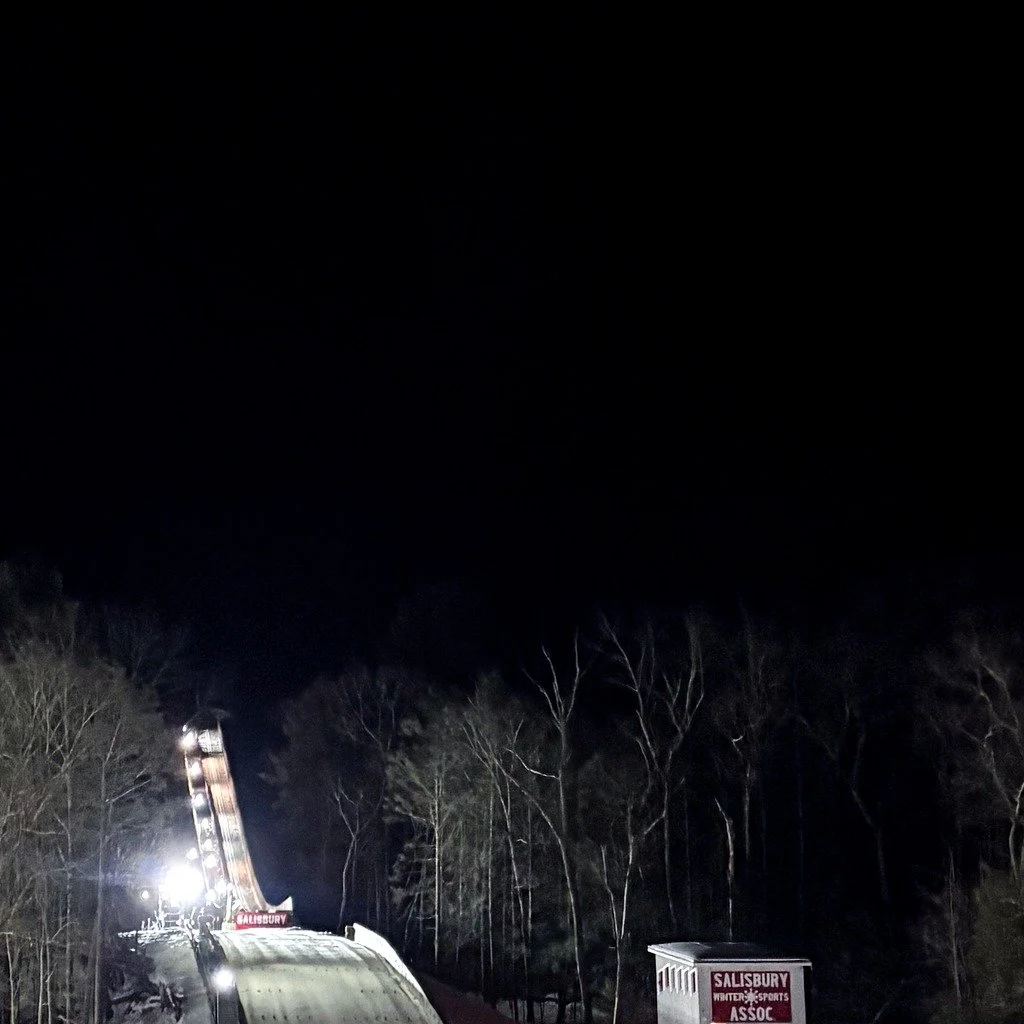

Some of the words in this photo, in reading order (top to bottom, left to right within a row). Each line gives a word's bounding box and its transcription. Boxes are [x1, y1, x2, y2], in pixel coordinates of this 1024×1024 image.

[236, 914, 286, 925] SALISBURY
[713, 972, 788, 988] SALISBURY
[713, 992, 745, 1002] WINTER
[758, 992, 789, 1002] SPORTS
[730, 1006, 773, 1021] ASSOC
